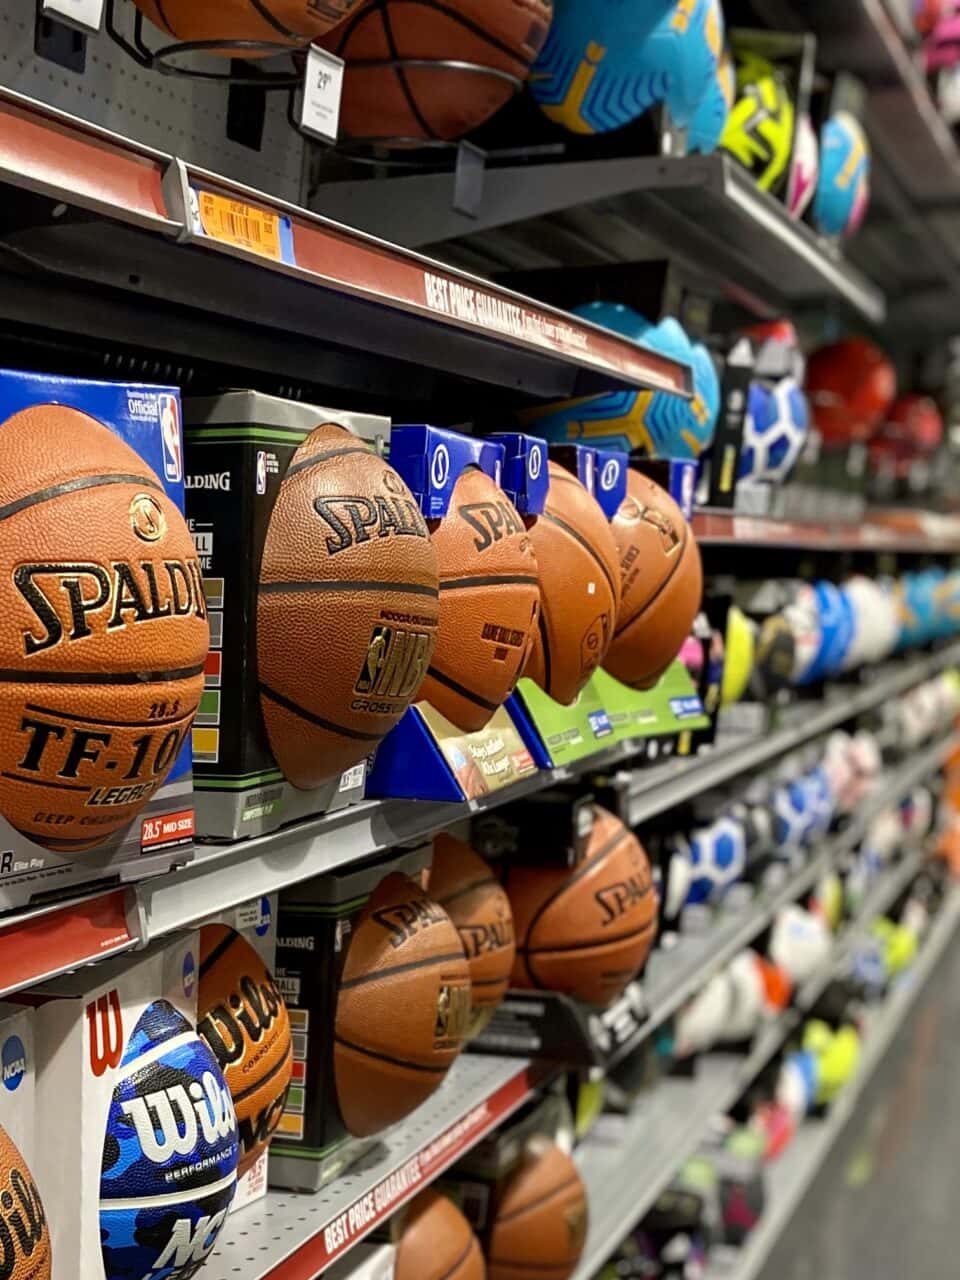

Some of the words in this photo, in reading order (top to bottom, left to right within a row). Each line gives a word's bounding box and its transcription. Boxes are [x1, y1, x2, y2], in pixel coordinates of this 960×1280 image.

[424, 272, 448, 312] BEST
[448, 281, 474, 321] PRICE
[3, 1058, 26, 1081] NCAA
[324, 1216, 349, 1255] BEST
[348, 1194, 376, 1236] PRICE
[374, 1155, 424, 1214] GUARANTEE
